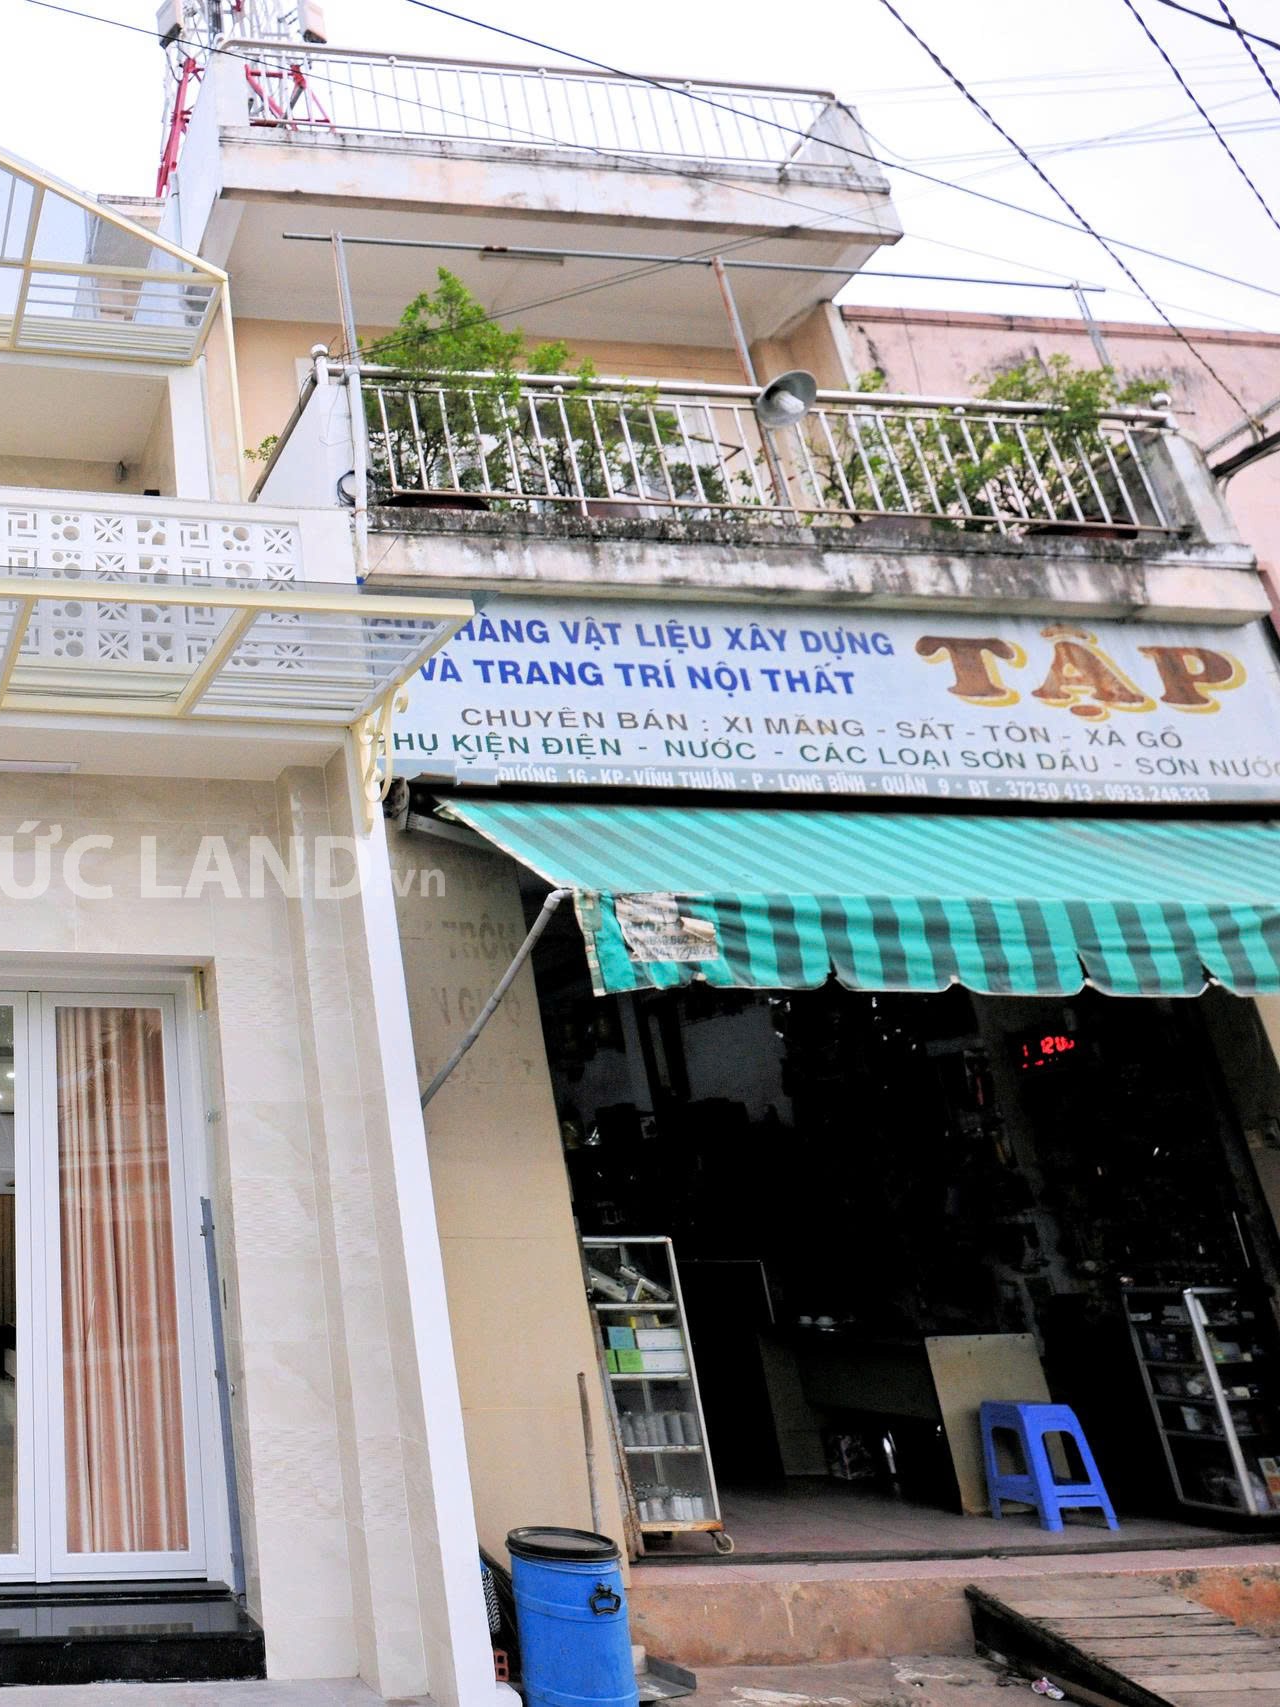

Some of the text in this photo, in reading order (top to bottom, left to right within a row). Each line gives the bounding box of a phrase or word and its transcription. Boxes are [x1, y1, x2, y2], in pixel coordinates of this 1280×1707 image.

[454, 612, 550, 644] HÀNG
[559, 617, 622, 652] VẬT
[635, 619, 712, 654] LIỆU
[727, 621, 787, 653] XÂY
[800, 626, 895, 661] DỰNG
[419, 651, 855, 698] VÀ TRANG TRÍ NỘI THẤT
[915, 624, 1248, 722] TẬP
[461, 707, 605, 730] CHUYÊN
[617, 707, 689, 732] BÁN
[724, 715, 753, 734] XI
[765, 715, 865, 738] MĂNG
[896, 716, 955, 742] SẮT
[988, 719, 1051, 744] TÔN
[377, 732, 438, 756] HỤ
[453, 732, 531, 760] KIỆN
[542, 733, 622, 760] ĐIỆN
[665, 734, 756, 761] NƯỚC
[799, 742, 867, 764] CÁC
[878, 747, 950, 770] LOẠI
[960, 748, 1026, 769] SƠN
[1136, 755, 1199, 776] SƠN
[1209, 756, 1280, 778] NƯỚ
[567, 768, 588, 784] 16
[600, 768, 624, 785] KP
[778, 773, 824, 792] LONG
[938, 778, 950, 796] 9
